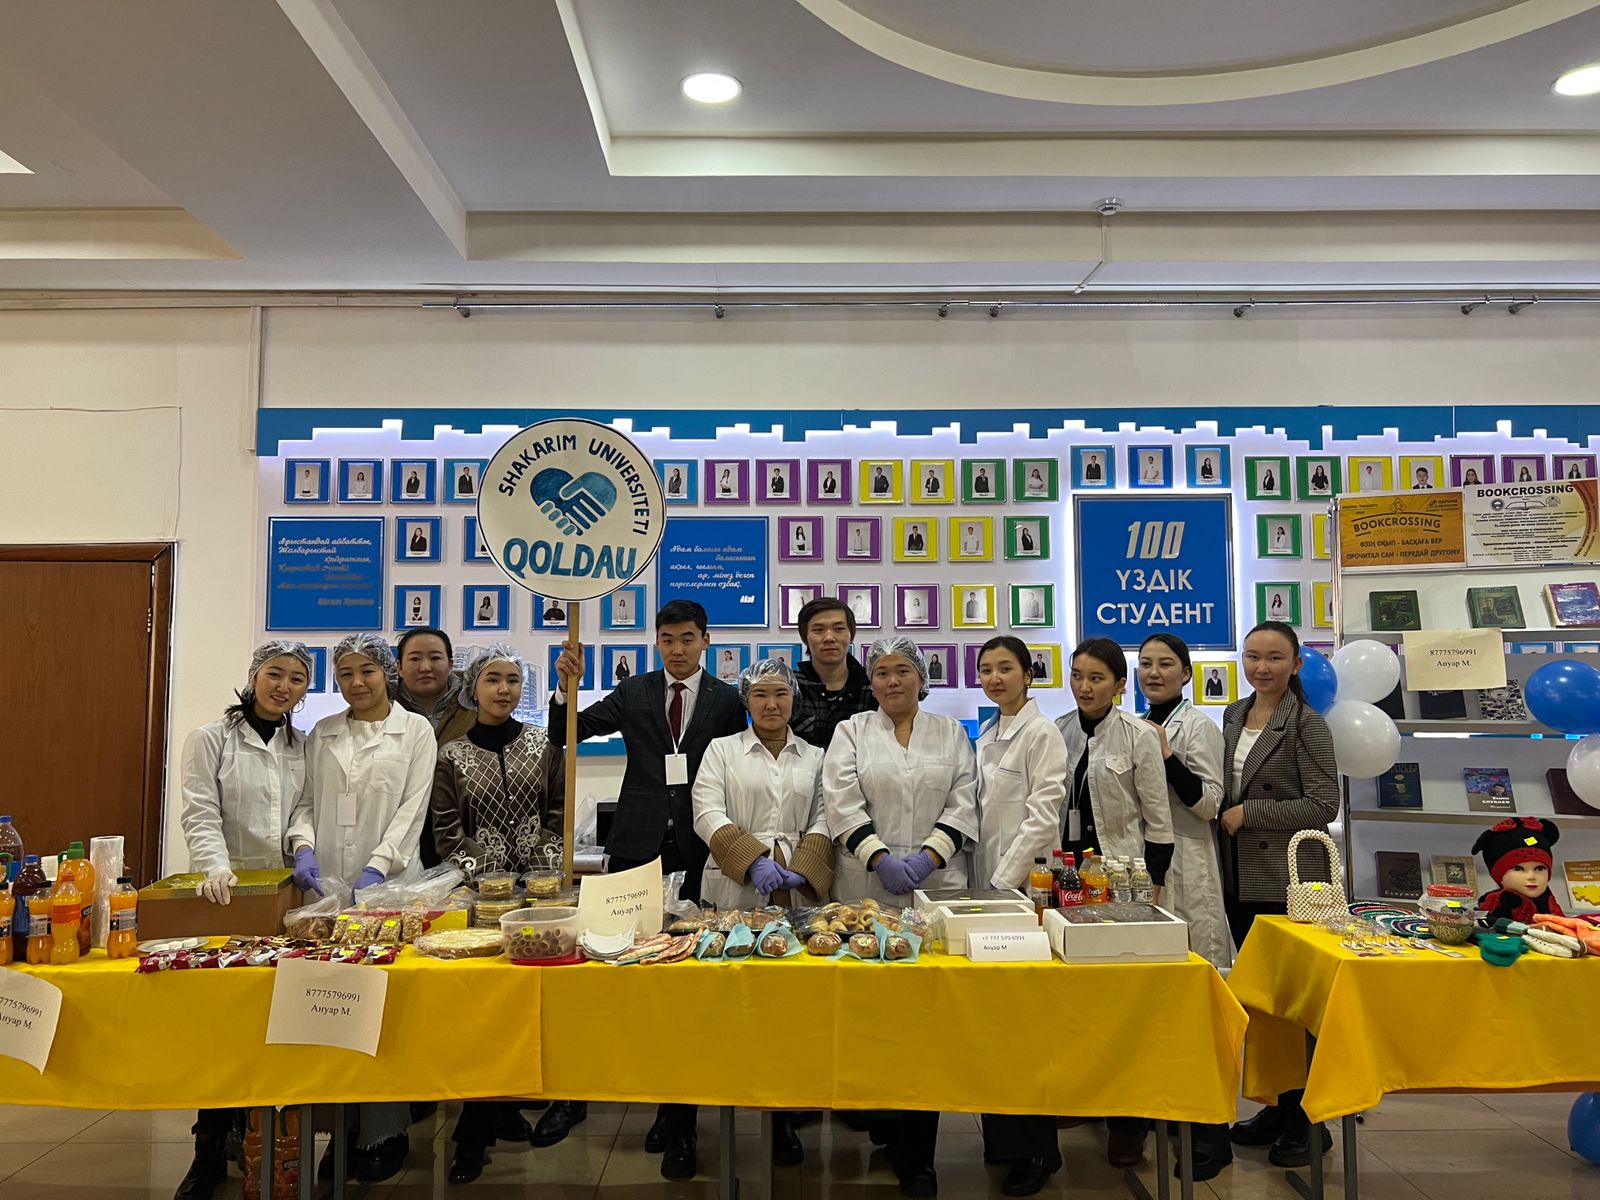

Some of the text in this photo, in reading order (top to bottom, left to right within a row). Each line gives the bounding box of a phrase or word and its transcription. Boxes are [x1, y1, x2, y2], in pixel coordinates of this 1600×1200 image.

[499, 434, 650, 536] SHAKARIM UNIVERSITETI
[1477, 484, 1574, 498] BOOKCROSSING
[1353, 516, 1441, 533] BOOKCROSSING
[1125, 521, 1186, 559] 100
[503, 537, 638, 580] QOLDAU
[1346, 552, 1380, 560] ПРОЧИТАЛ
[1400, 549, 1429, 558] ПЕРЕДАЙ
[1115, 568, 1194, 593] ҮЗДІК
[1096, 602, 1215, 627] СТУДЕНТ
[1429, 648, 1477, 656] 87775796991
[1436, 660, 1461, 669] Ануар
[605, 888, 649, 905] 87775796991
[610, 907, 634, 917] Ануар
[305, 988, 361, 1003] 87775796991
[310, 1004, 340, 1016] Ануар
